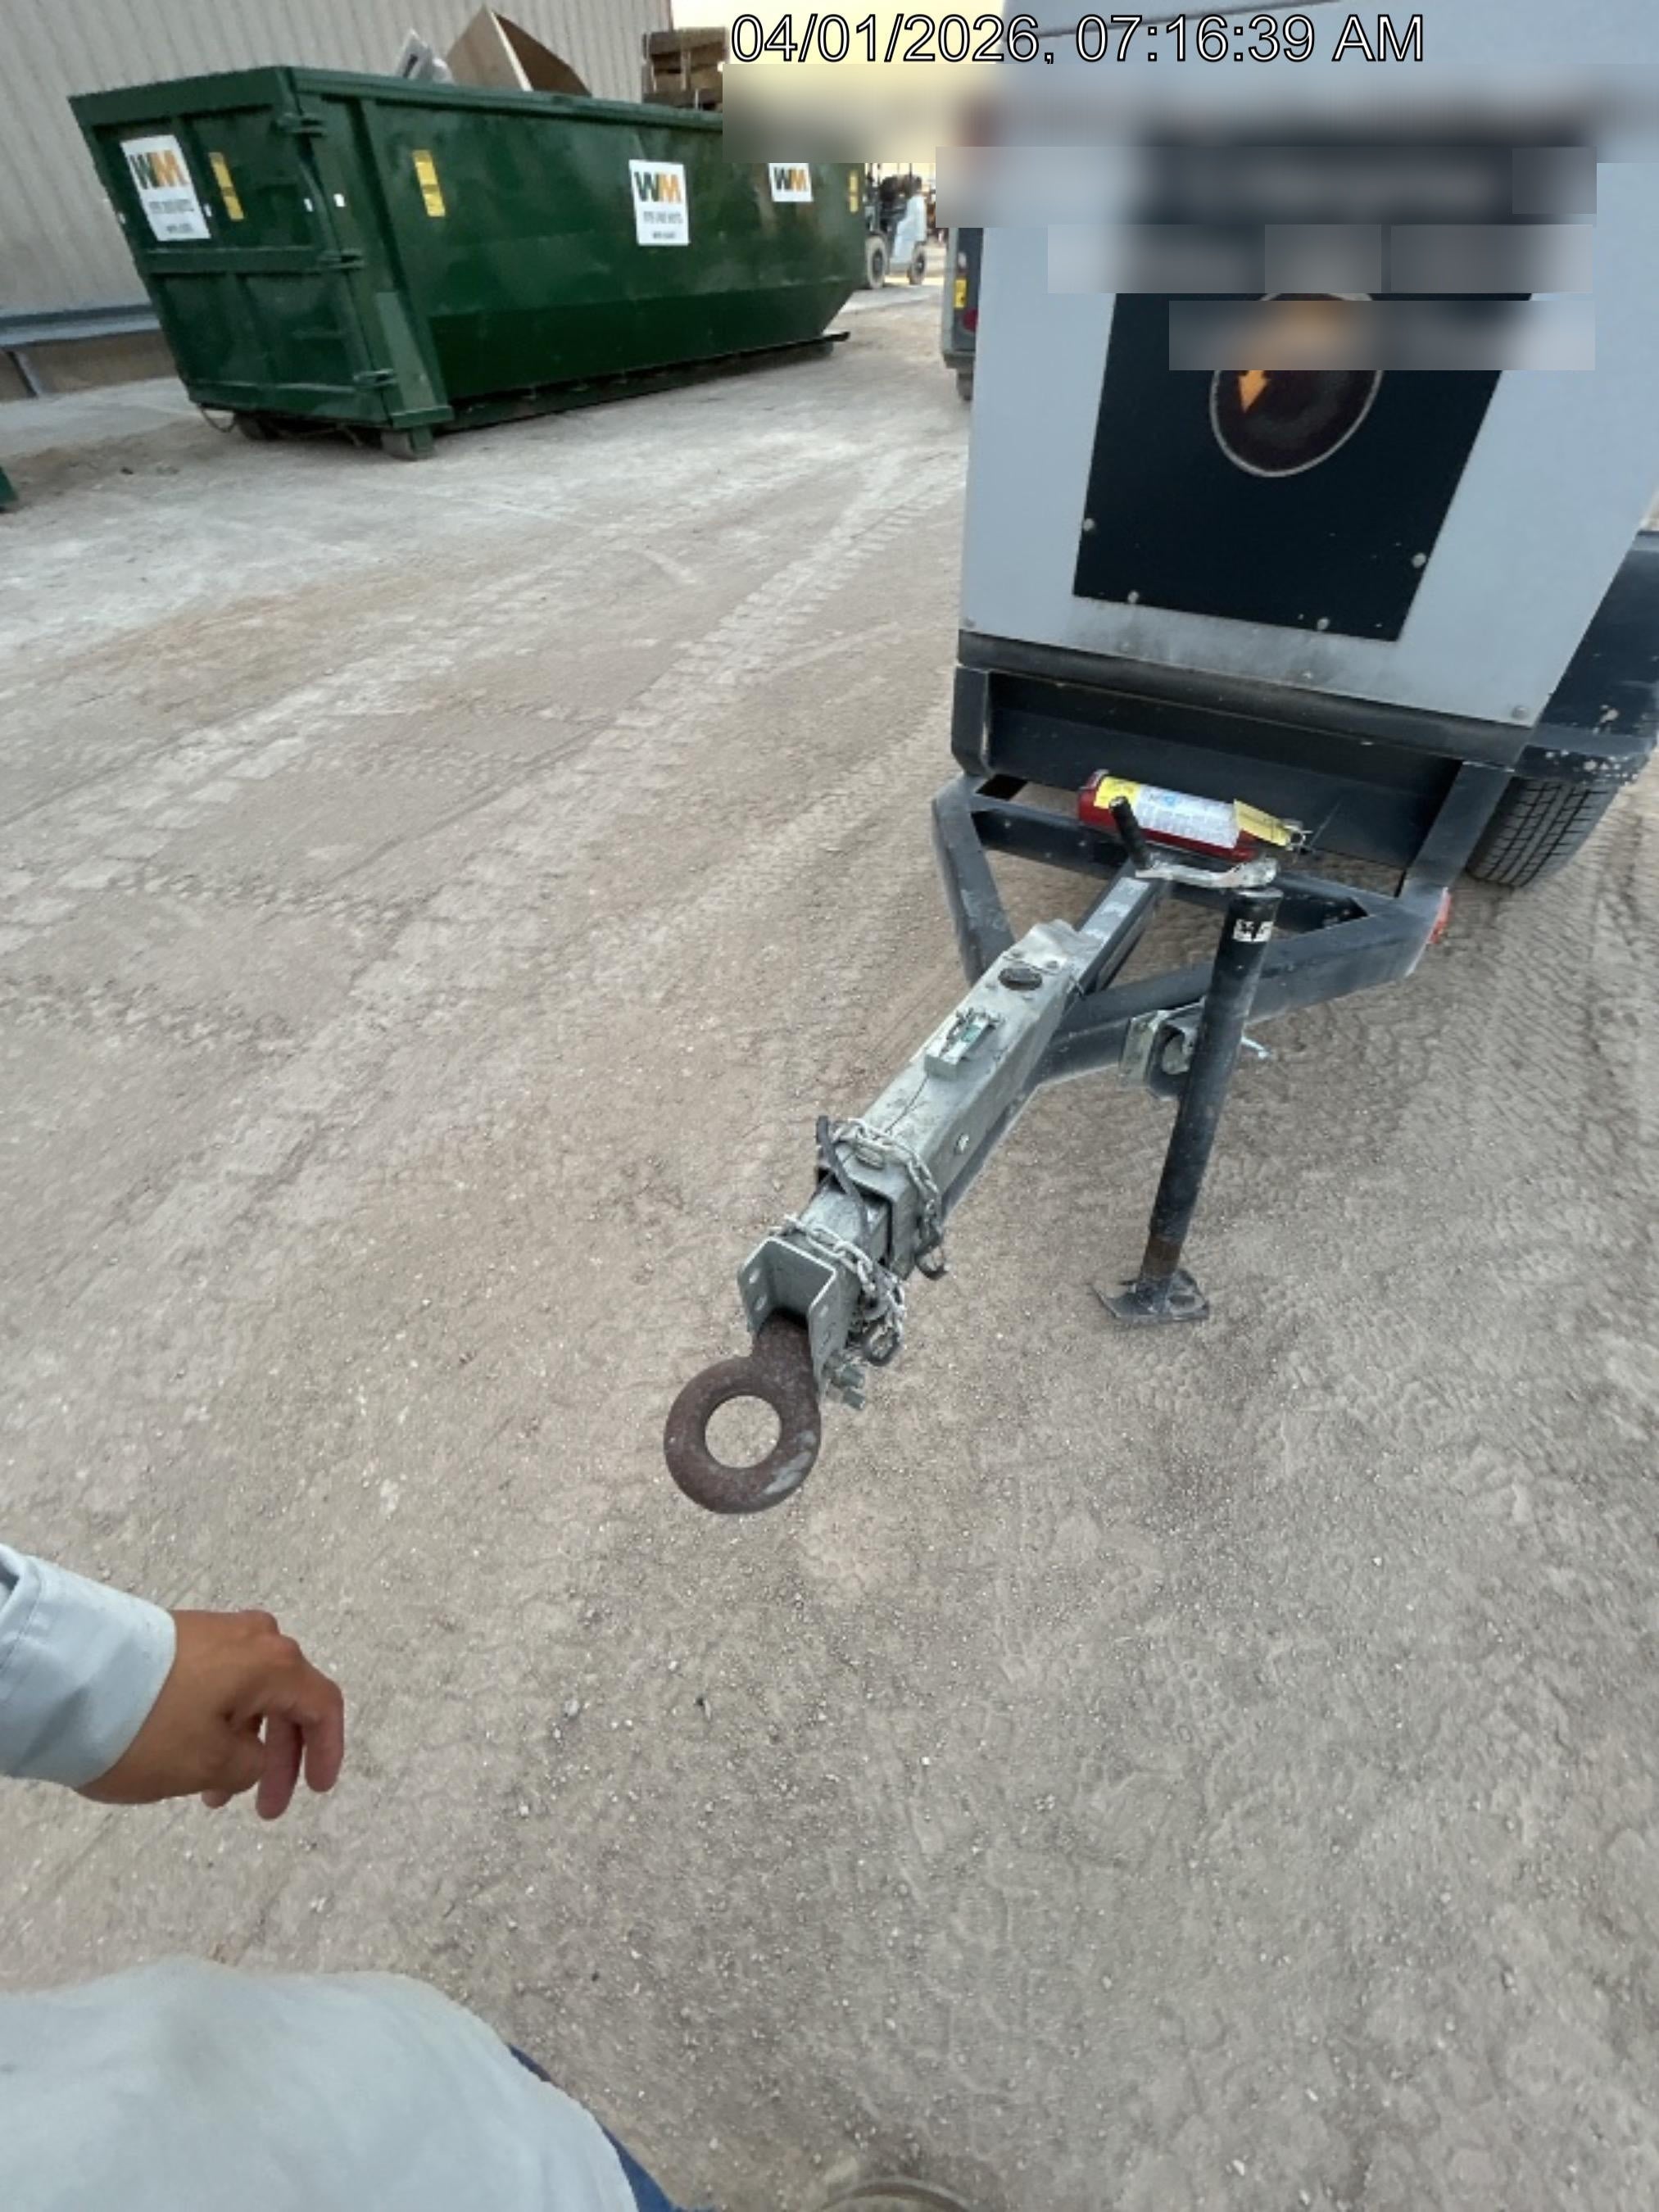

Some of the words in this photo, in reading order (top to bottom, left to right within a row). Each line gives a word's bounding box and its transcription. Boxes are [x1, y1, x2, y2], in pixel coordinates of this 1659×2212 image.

[128, 150, 189, 189] WM
[774, 167, 806, 191] WM
[634, 171, 682, 203] WM
